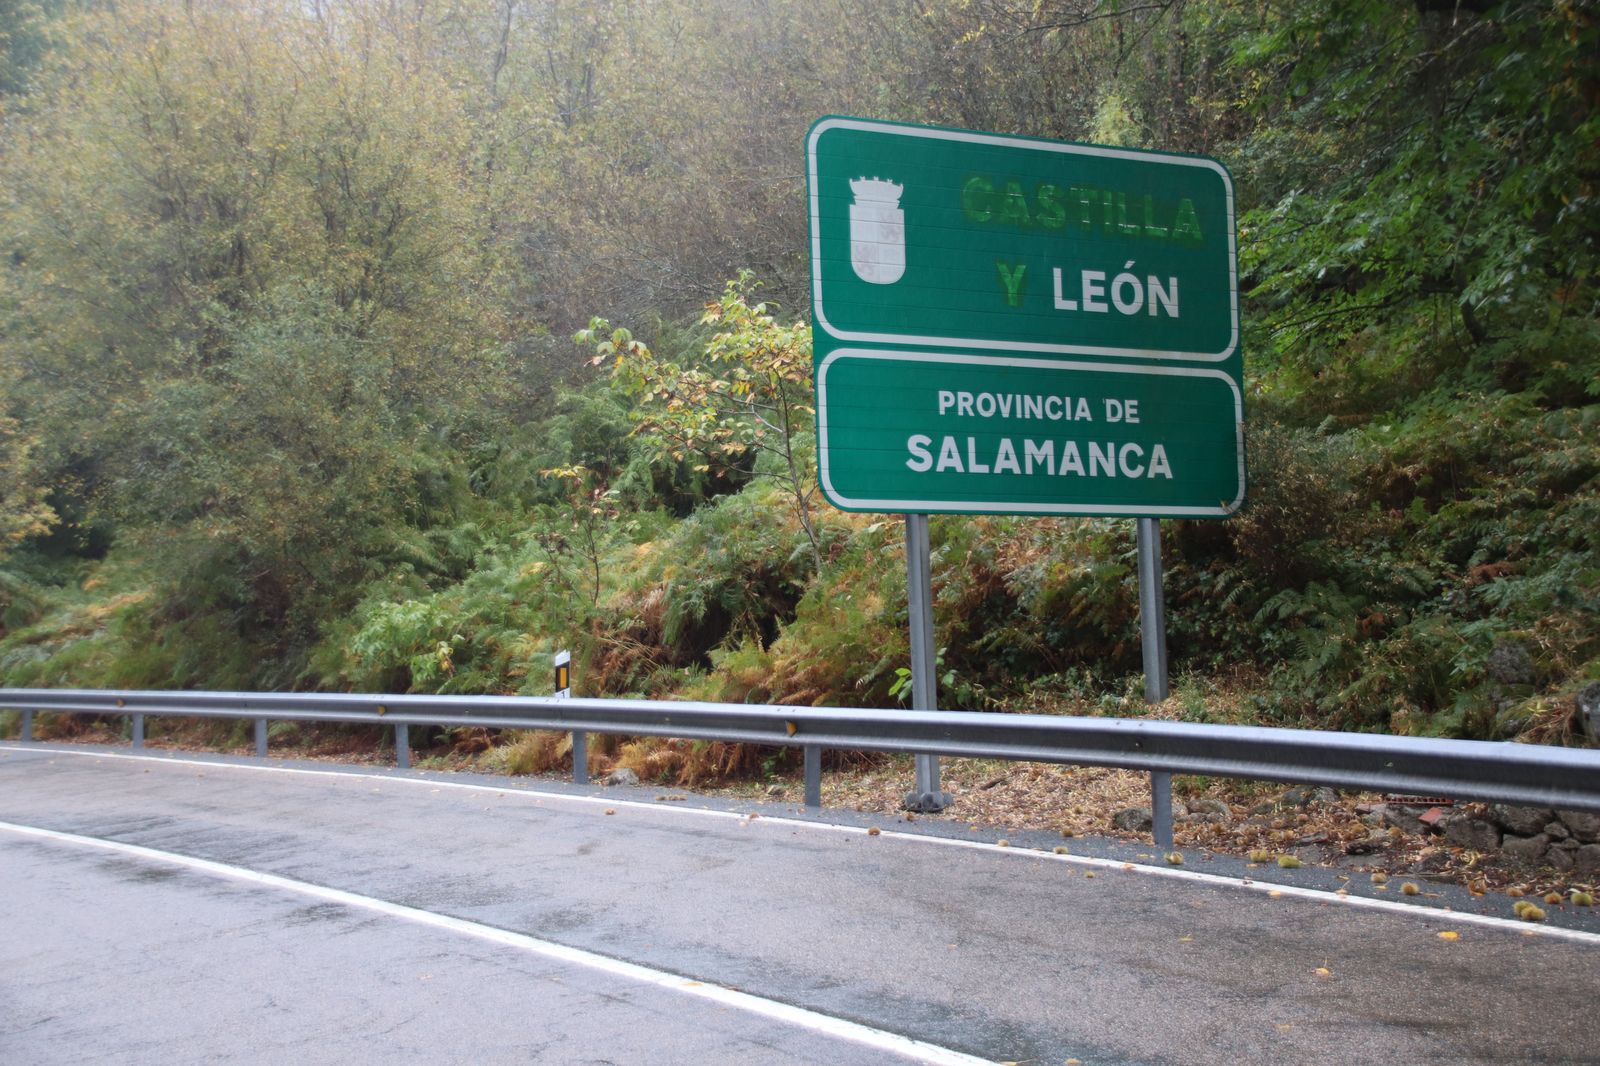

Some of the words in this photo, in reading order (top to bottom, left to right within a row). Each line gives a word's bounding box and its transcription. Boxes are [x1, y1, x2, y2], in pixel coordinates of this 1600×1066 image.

[962, 176, 1203, 241] CASTILLA
[996, 260, 1027, 307] Y
[1052, 260, 1180, 319] LEÓN
[937, 390, 1093, 422] PROVINCIA
[1104, 398, 1141, 424] DE
[905, 434, 1174, 479] SALAMANCA
